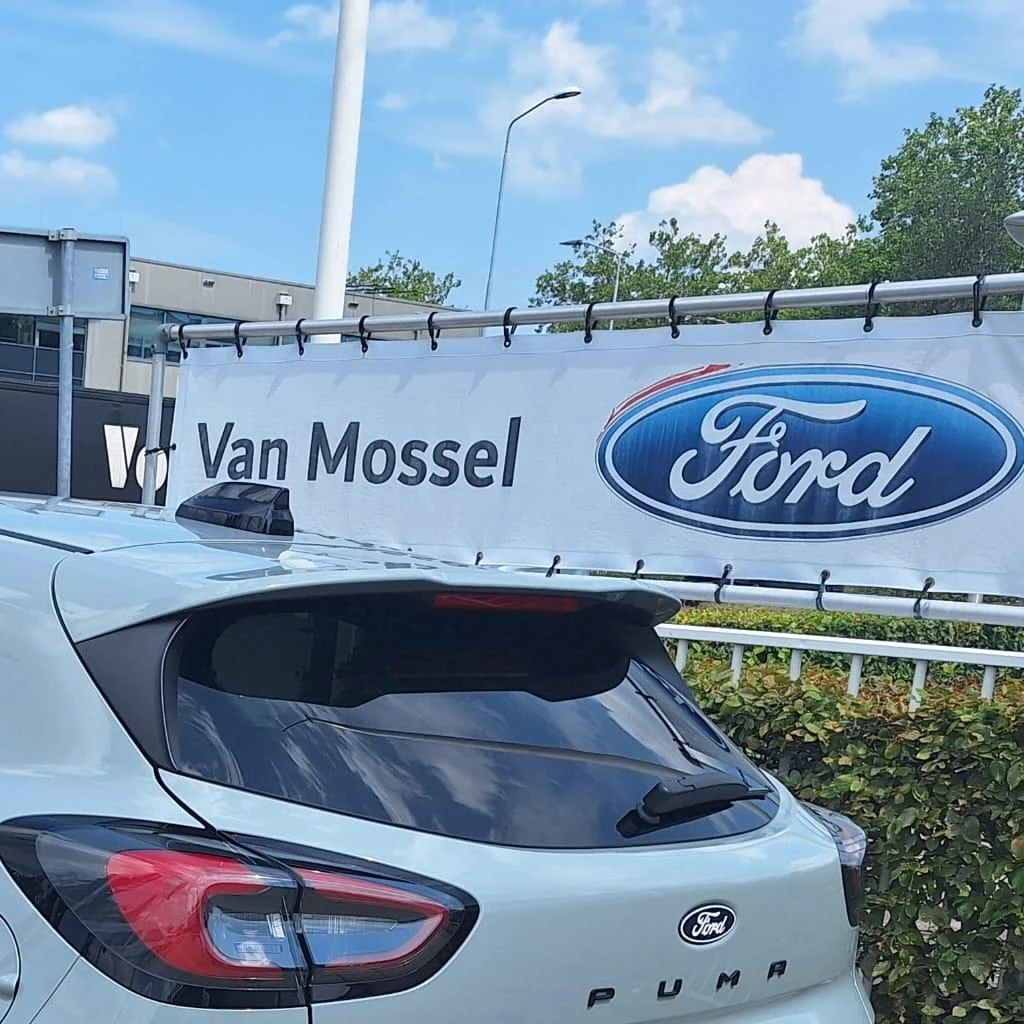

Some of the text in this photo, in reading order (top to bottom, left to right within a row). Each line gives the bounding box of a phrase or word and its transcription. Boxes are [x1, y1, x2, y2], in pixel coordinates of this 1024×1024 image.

[197, 416, 522, 488] Van Mossel
[669, 394, 933, 509] Ford
[691, 911, 728, 937] Ford
[586, 959, 787, 1010] PUMA
